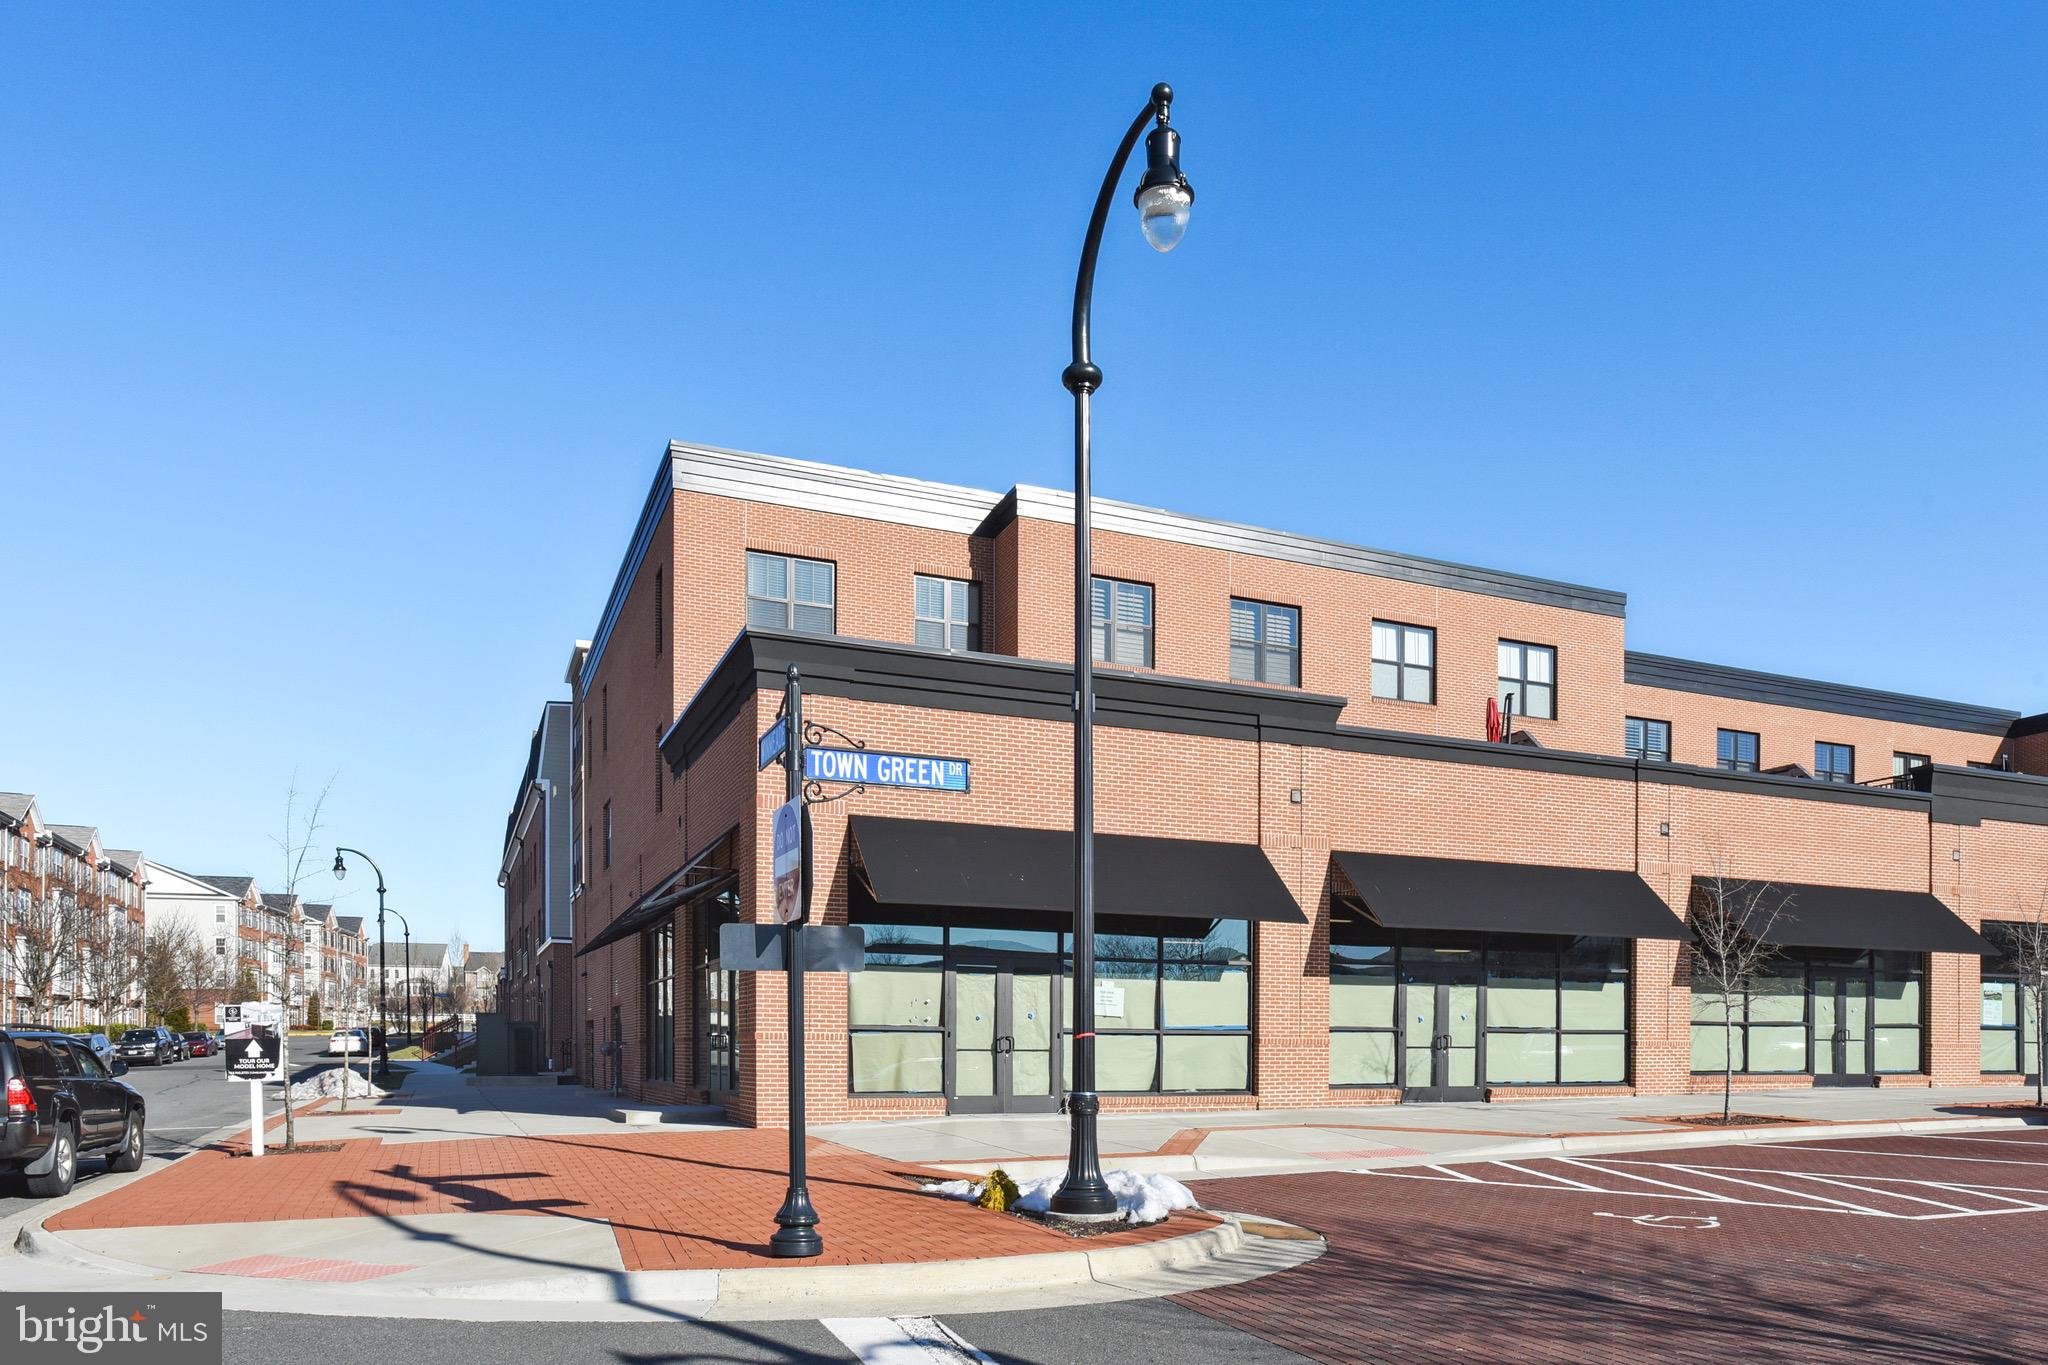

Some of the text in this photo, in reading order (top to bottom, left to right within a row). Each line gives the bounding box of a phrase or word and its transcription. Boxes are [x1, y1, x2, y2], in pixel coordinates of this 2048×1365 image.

[811, 751, 963, 786] TOWN GREEN DR
[776, 823, 796, 851] DO NOT
[776, 879, 795, 901] ENTER
